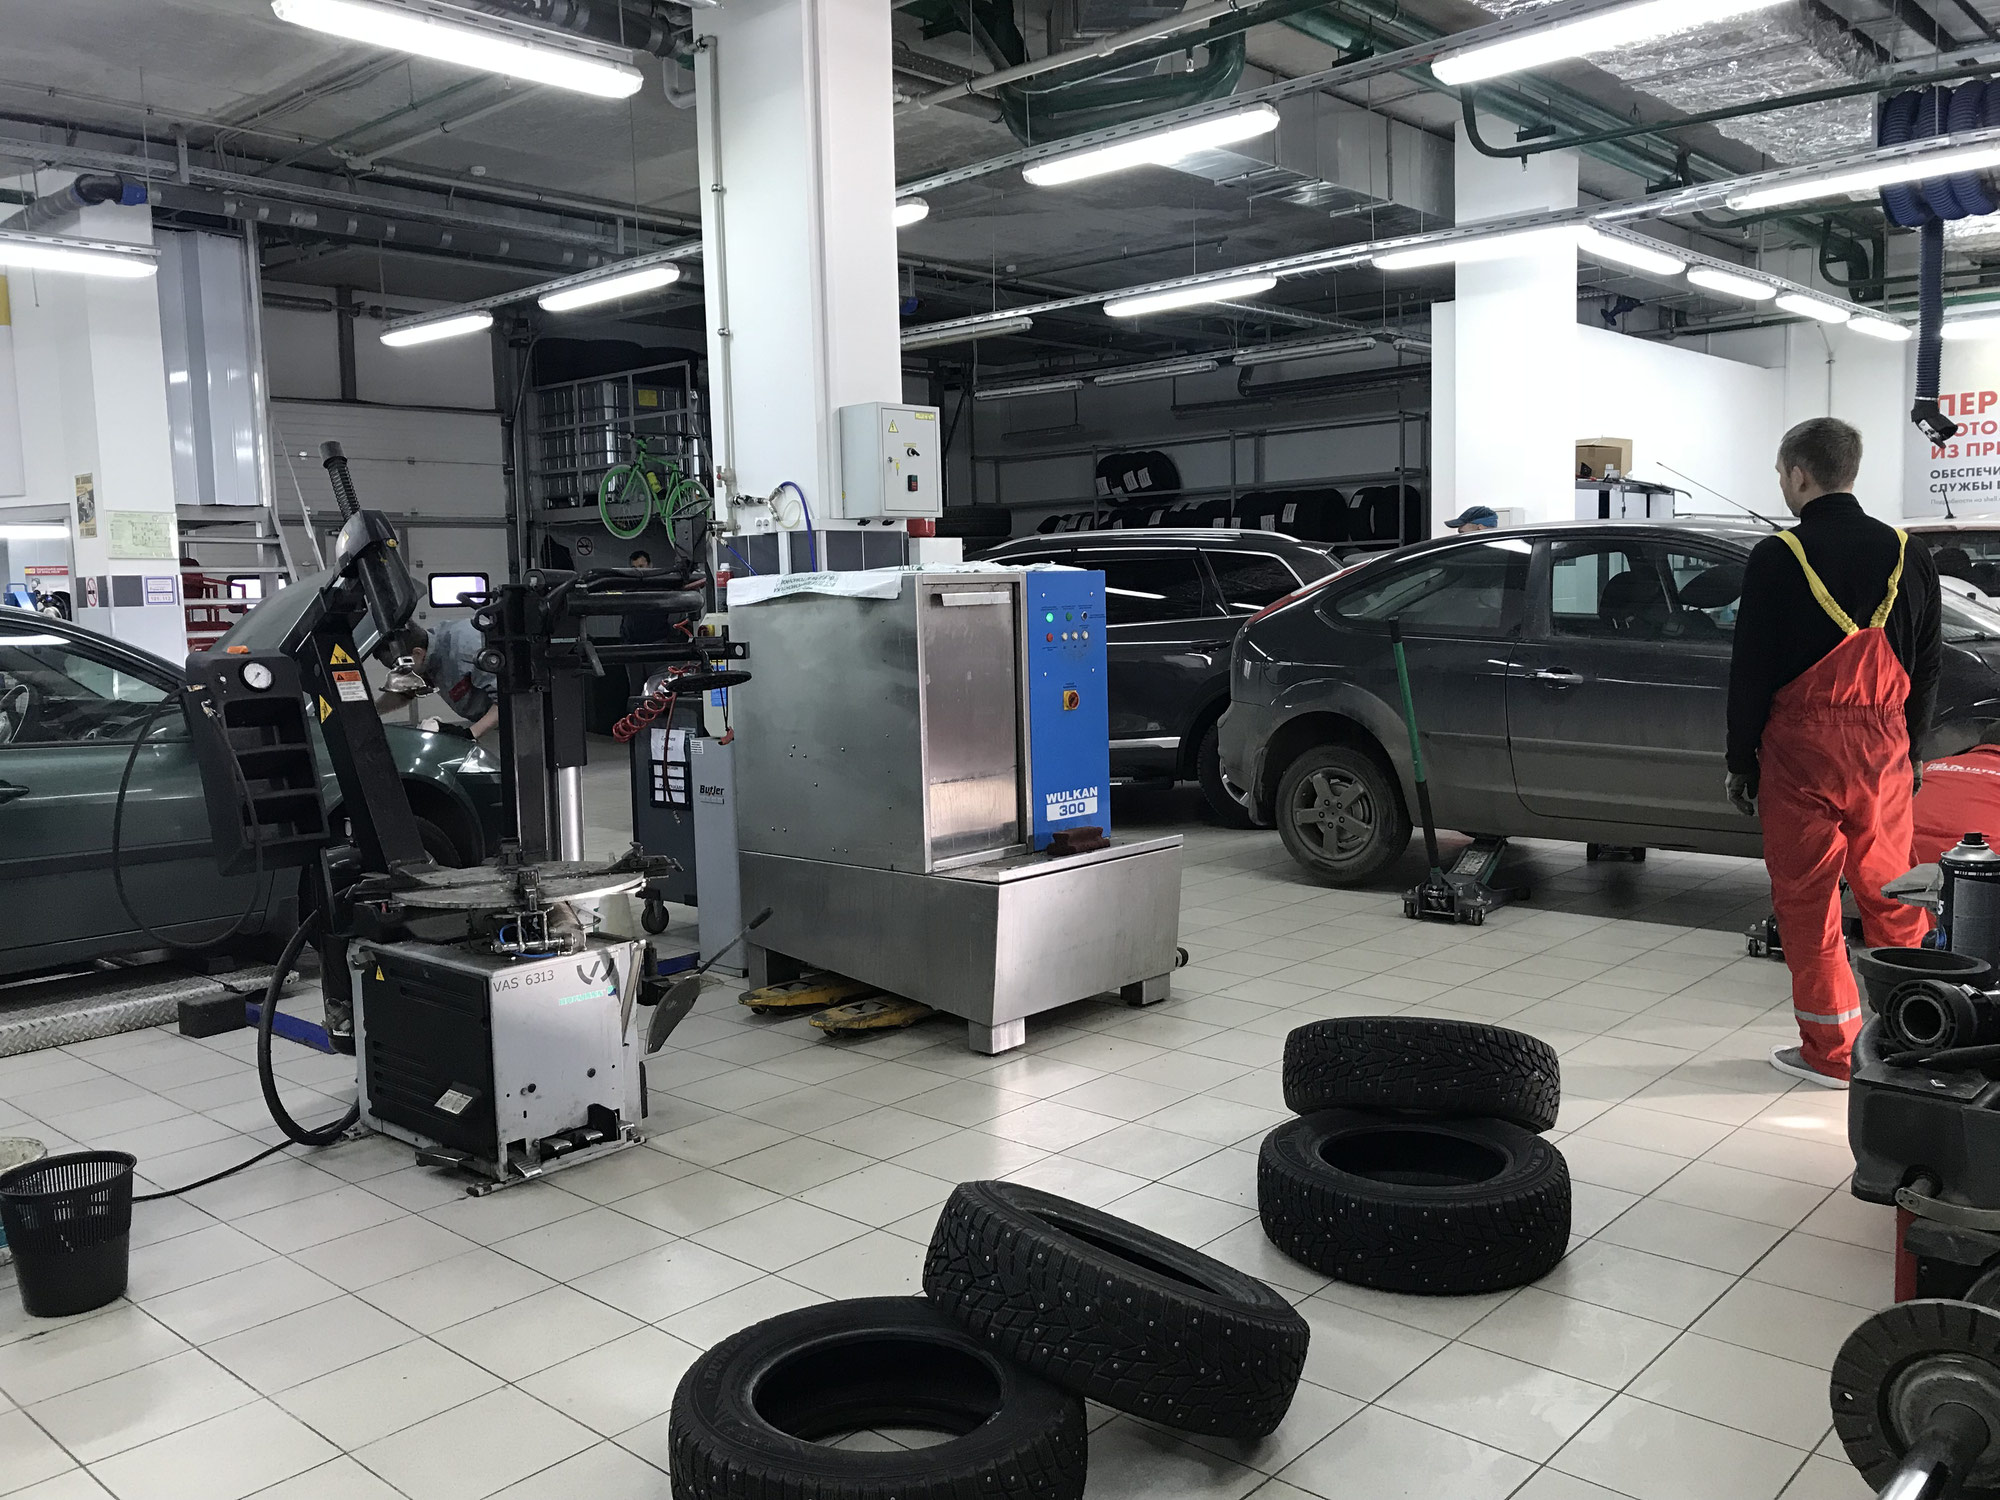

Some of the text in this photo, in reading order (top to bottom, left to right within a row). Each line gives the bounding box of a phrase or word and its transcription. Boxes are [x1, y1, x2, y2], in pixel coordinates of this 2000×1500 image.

[1937, 391, 1998, 416] ПЕР
[1952, 420, 1998, 437] ОТО
[1931, 441, 2000, 459] ИЗ ПР
[1929, 480, 1993, 493] СЛУЖБЫ
[699, 784, 725, 796] Butler
[1046, 786, 1098, 804] WULKAN
[1059, 801, 1086, 817] 300
[493, 969, 554, 992] VAS 6313
